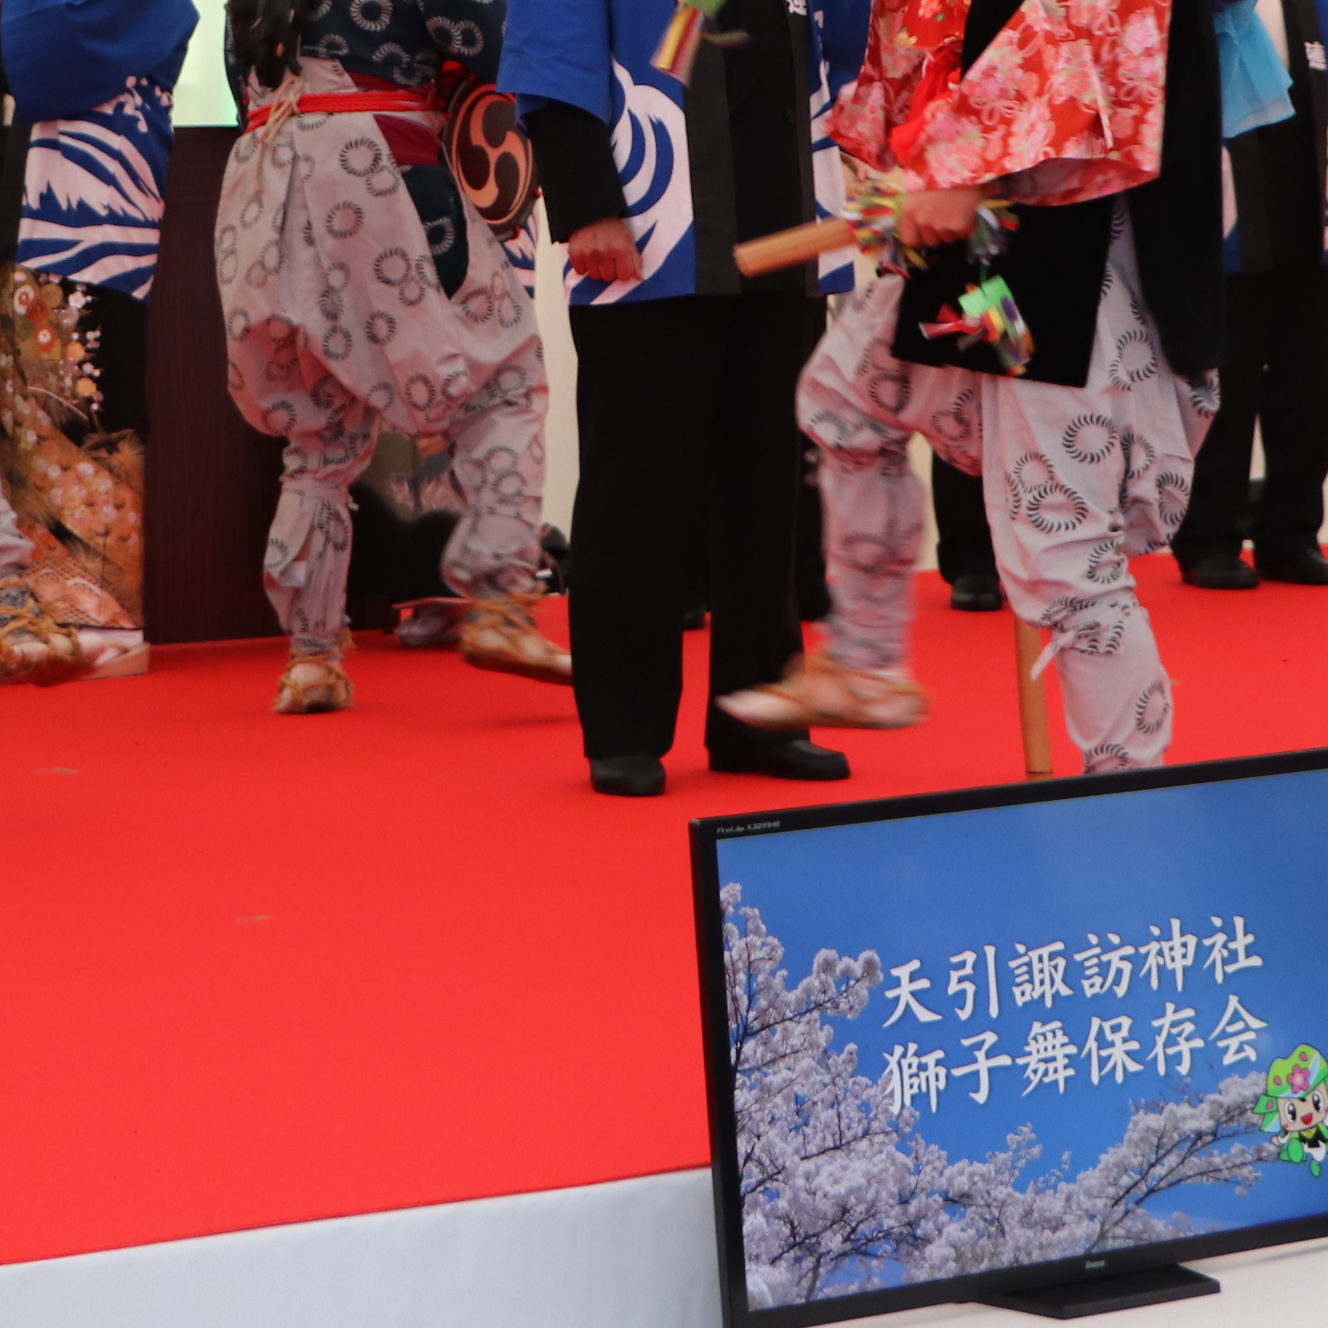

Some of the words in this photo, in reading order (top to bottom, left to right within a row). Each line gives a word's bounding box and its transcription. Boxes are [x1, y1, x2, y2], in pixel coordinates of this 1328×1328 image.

[881, 915, 1265, 1029] 天引諏訪神社
[881, 993, 1269, 1116] 獅子舞保存会
